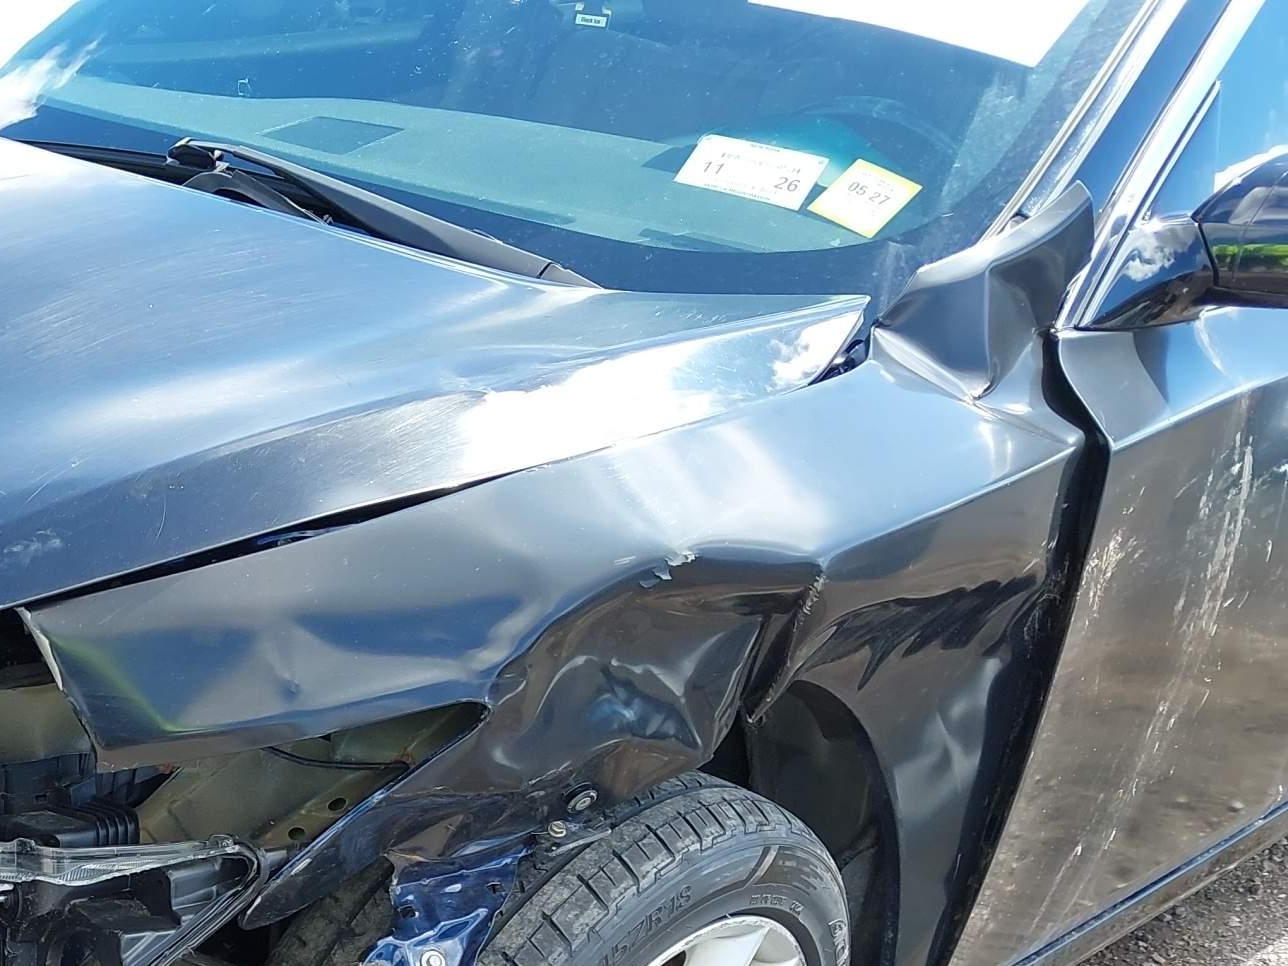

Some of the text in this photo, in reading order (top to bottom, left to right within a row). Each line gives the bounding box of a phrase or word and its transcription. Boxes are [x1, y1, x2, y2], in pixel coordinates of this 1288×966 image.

[773, 176, 801, 192] 26
[847, 181, 891, 206] 05 27
